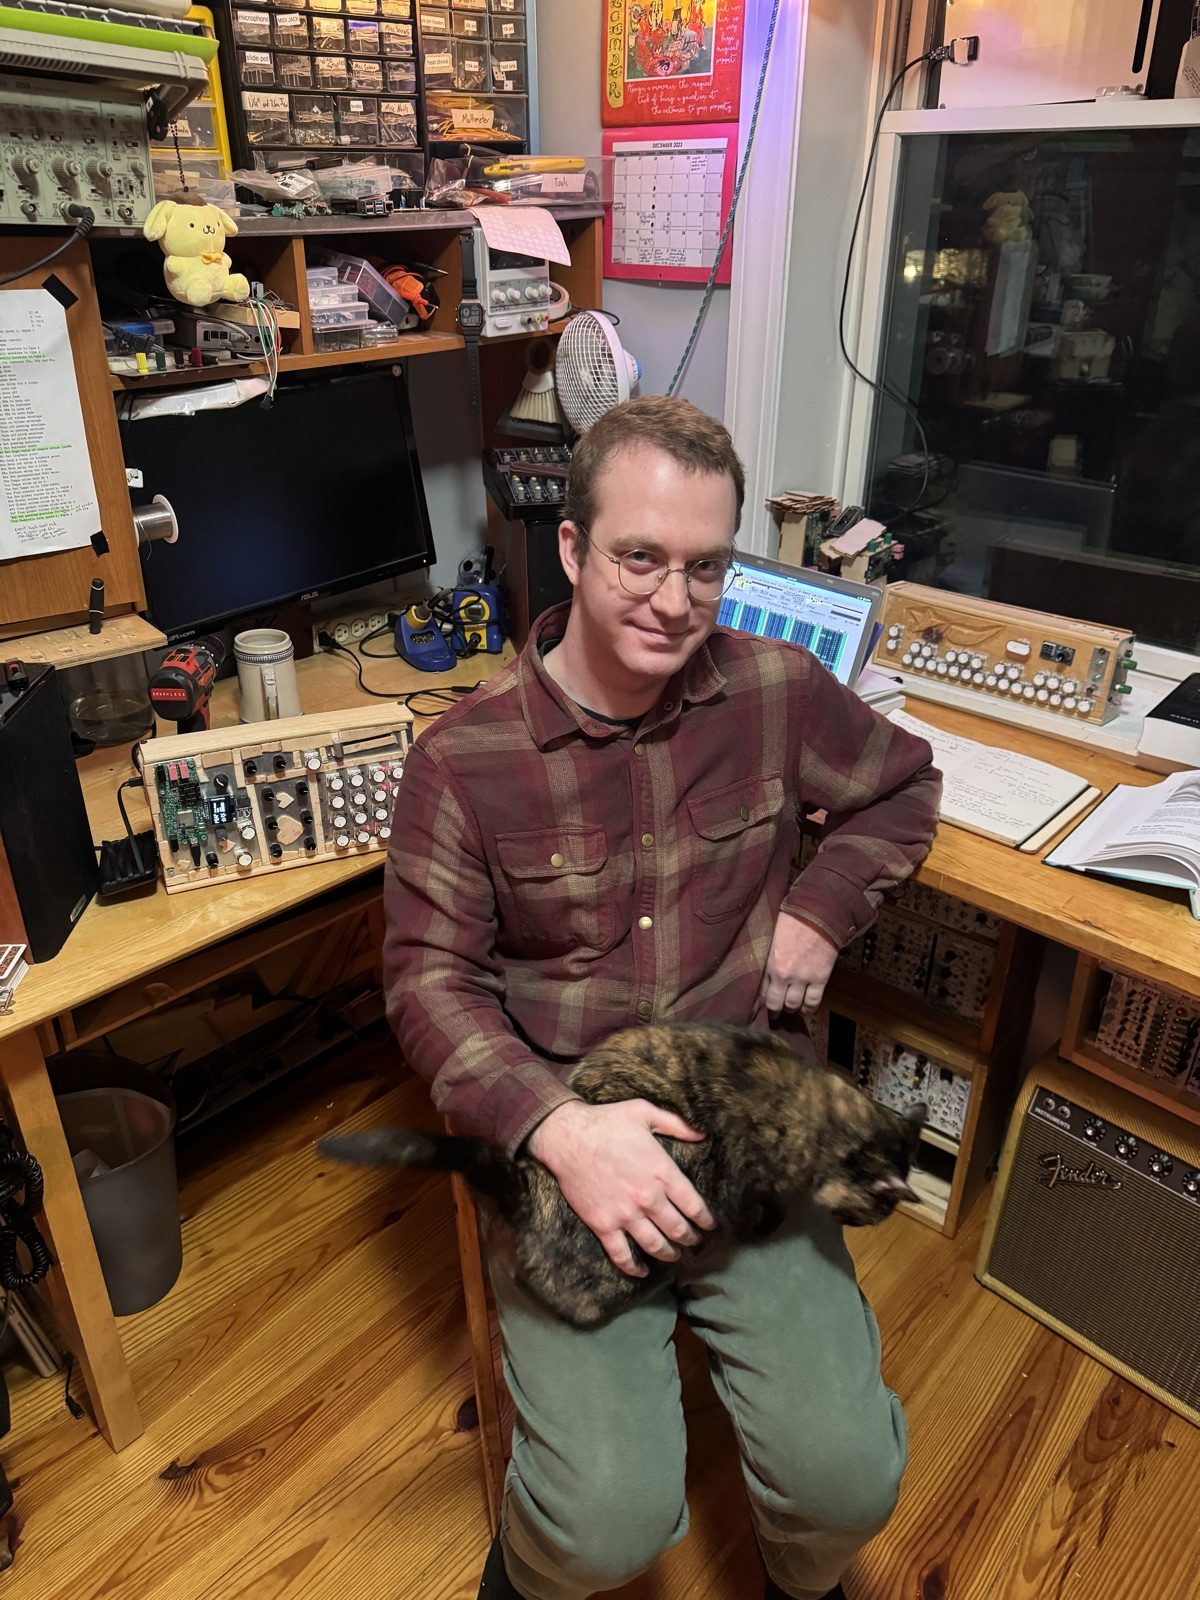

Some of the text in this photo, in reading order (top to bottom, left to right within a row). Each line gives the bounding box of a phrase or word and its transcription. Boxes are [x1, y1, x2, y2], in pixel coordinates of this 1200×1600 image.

[462, 113, 490, 125] Multimeter
[554, 176, 568, 188] Tools
[300, 591, 319, 601] ASUS
[1034, 1107, 1071, 1131] INSTRUMENTS
[1038, 1153, 1122, 1190] Fender
